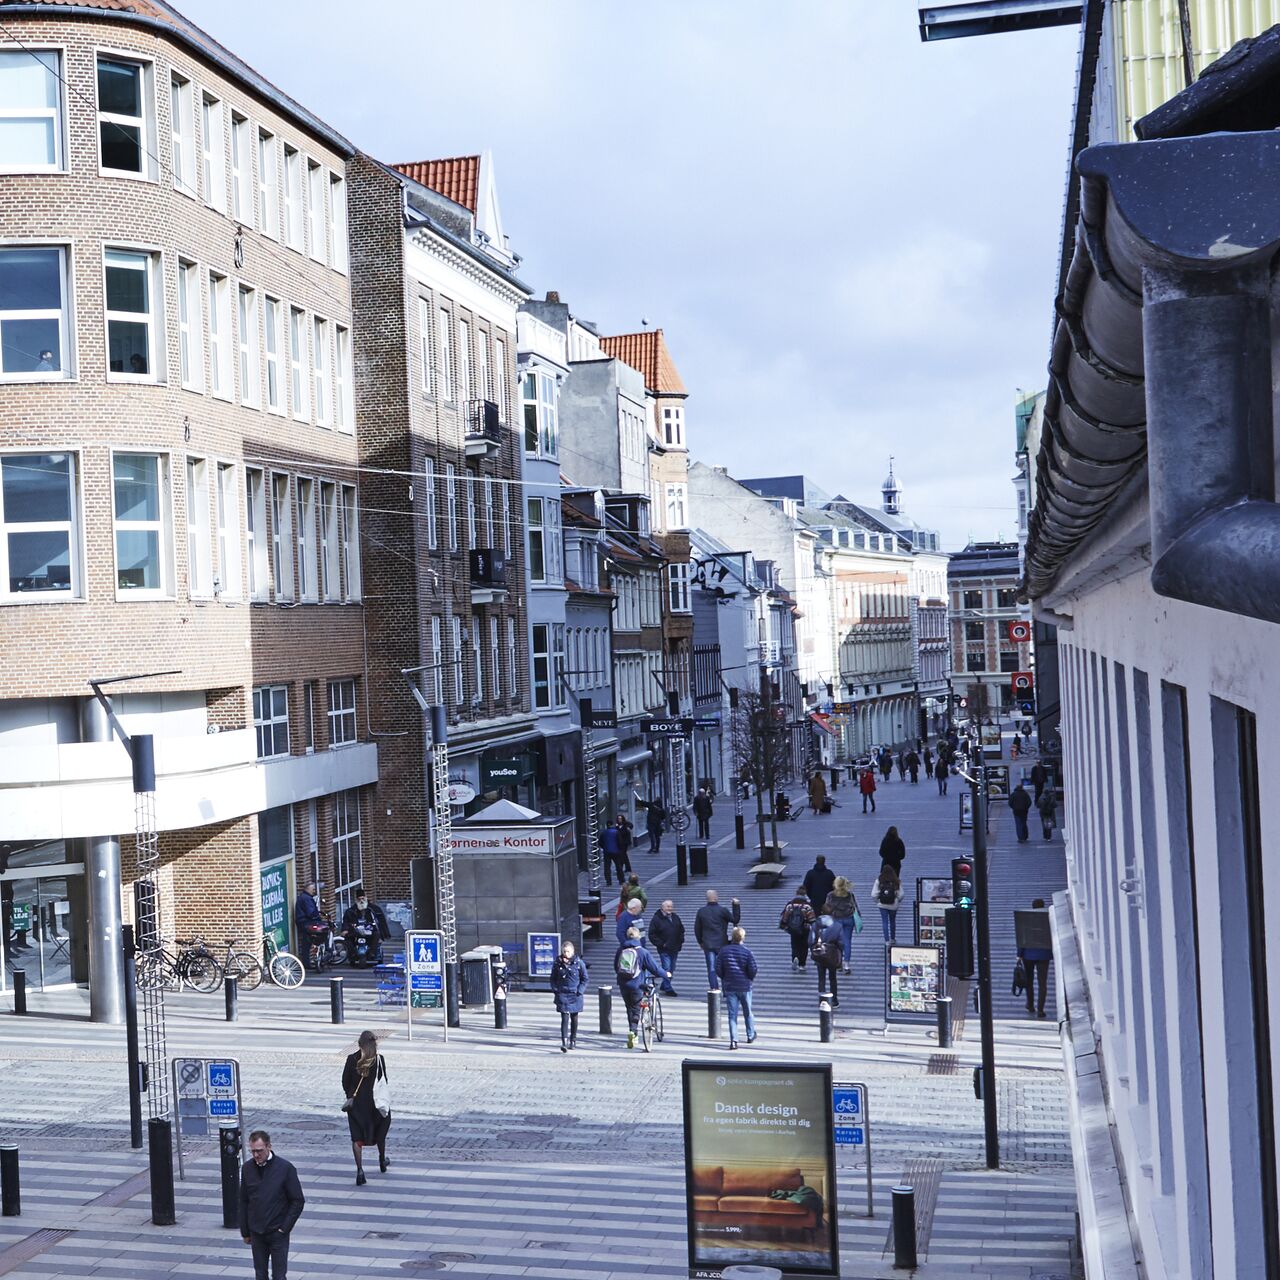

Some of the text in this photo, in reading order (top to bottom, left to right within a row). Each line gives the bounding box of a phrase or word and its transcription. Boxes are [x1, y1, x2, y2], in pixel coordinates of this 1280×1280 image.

[489, 768, 517, 777] youSee
[503, 837, 547, 848] Kontor
[714, 1101, 799, 1117] Dansk design
[703, 1115, 714, 1123] fra
[735, 1116, 758, 1125] fabrik
[759, 1117, 788, 1126] direkte
[788, 1118, 797, 1126] til
[798, 1118, 811, 1128] dig
